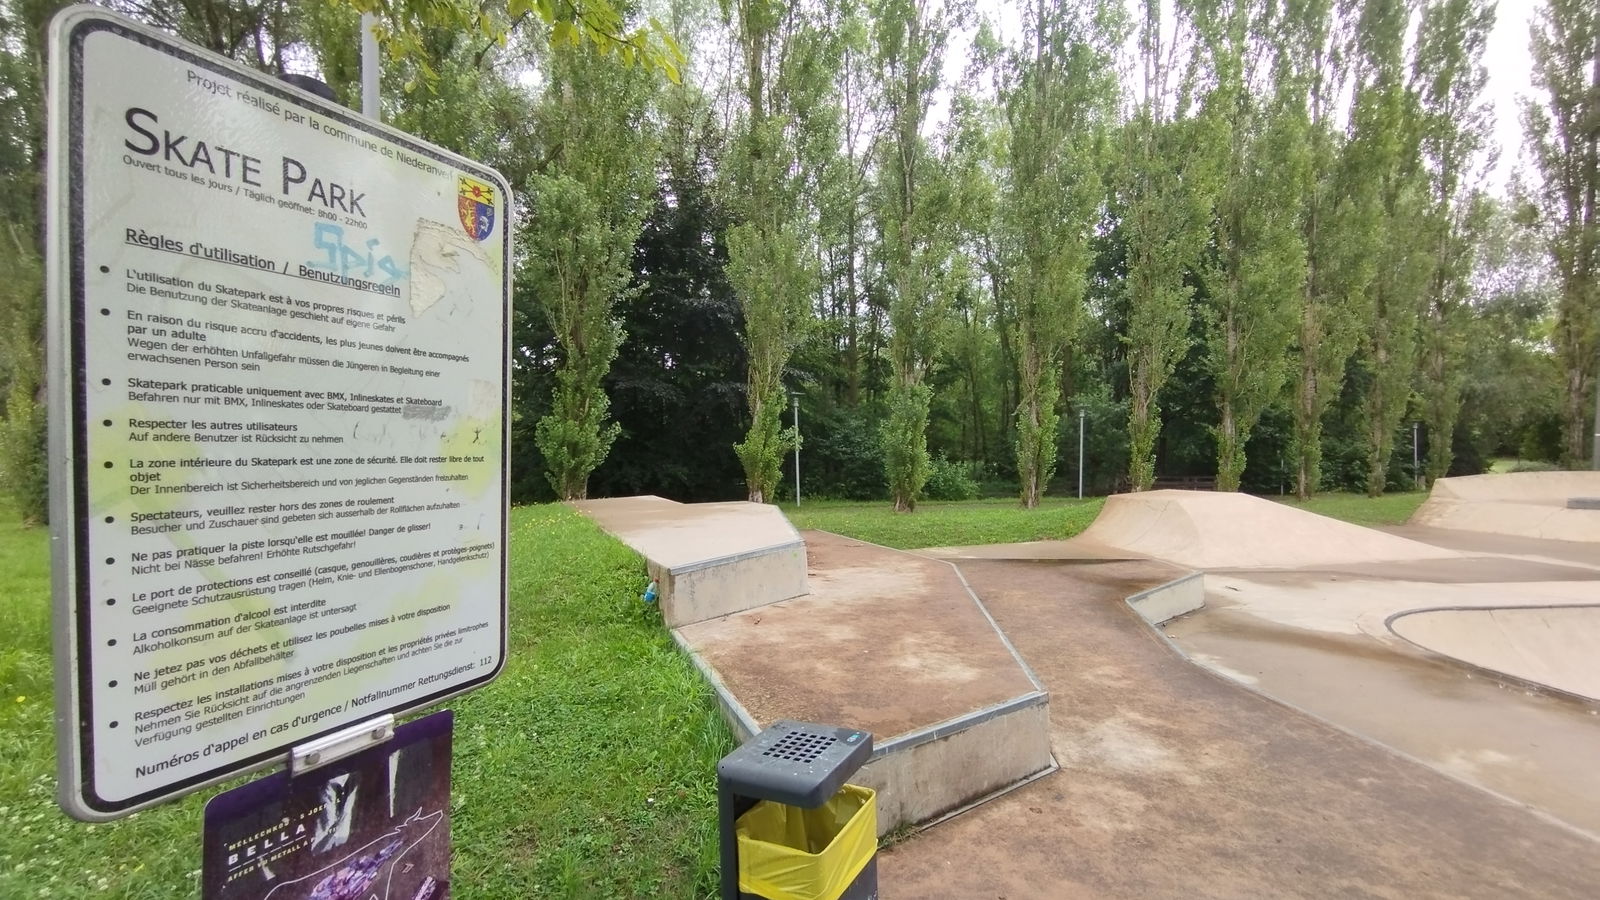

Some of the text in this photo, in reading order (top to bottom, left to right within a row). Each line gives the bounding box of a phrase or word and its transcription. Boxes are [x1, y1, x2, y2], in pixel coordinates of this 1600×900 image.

[186, 69, 232, 98] Projet
[236, 90, 280, 116] réalisé
[284, 109, 306, 124] par
[308, 116, 319, 130] la
[322, 124, 378, 152] commune
[379, 145, 393, 159] de
[122, 154, 161, 174] Ouvert
[163, 166, 188, 180] tous
[190, 172, 205, 185] les
[208, 178, 233, 192] jours
[242, 187, 275, 204] Täglich
[277, 199, 315, 215] geöffnet:
[317, 208, 337, 222] 8h00
[344, 216, 367, 230] 22h00
[125, 227, 184, 255] Règles
[298, 264, 400, 297] Benutzungsregeln
[126, 282, 208, 306] Die Benutzung
[197, 281, 212, 292] du
[215, 283, 266, 301] Skatepark
[268, 294, 284, 304] est
[294, 299, 310, 308] vos
[312, 302, 344, 314] propres
[127, 325, 206, 342] par un adulte
[127, 309, 143, 321] En
[147, 313, 183, 326] raison
[186, 318, 201, 328] du
[204, 320, 238, 333] risque
[427, 351, 469, 362] accompagnés
[127, 337, 330, 366] Wegen der erhöhten müssen
[127, 352, 238, 369] erwachsenen Person
[127, 377, 442, 406] Skatepark praticable uniquement avec BMX, Skateboard
[128, 390, 369, 412] Befahren nur mit BMX, oder Skateboard
[128, 418, 298, 431] Respecter les autres utilisateurs
[128, 431, 344, 443] Auf andere Benutzer nehmen
[129, 458, 144, 468] La
[147, 459, 176, 468] zone
[179, 456, 232, 467] intérieure
[234, 457, 248, 466] du
[250, 456, 298, 467] Skatepark
[299, 457, 314, 466] est
[333, 457, 353, 465] zone
[354, 456, 365, 464] de
[366, 455, 398, 464] sécurité.
[129, 471, 161, 483] objet
[129, 482, 224, 495] Der Innenbereich
[130, 498, 355, 523] Spectateurs, veuillez rester hors des zones de
[130, 513, 316, 535] Besucher und Zuschauer gebeten
[131, 552, 148, 562] Ne
[151, 550, 172, 562] pas
[176, 544, 226, 559] pratiquer
[228, 542, 238, 551] la
[241, 540, 265, 552] piste
[314, 533, 328, 542] est
[368, 527, 395, 536] Danger
[131, 551, 263, 575] Nicht Nässe befahren!
[132, 551, 431, 602] Le port de protections est conseillé (casque, coudières
[132, 585, 276, 615] Geeignete Schutzausrüstung
[132, 632, 147, 642] La
[151, 616, 230, 638] consommation
[272, 605, 288, 615] est
[132, 603, 357, 655] Alkoholkonsum auf untersagt
[134, 671, 150, 682] Ne
[153, 663, 183, 679] jetez
[186, 658, 205, 672] pas
[208, 653, 227, 664] vos
[229, 644, 268, 660] déchets
[270, 640, 280, 650] et
[134, 665, 230, 695] Müll gehört den
[134, 699, 193, 721] Respectez
[196, 694, 212, 705] les
[215, 677, 274, 700] installations
[276, 670, 302, 683] mises
[335, 650, 376, 667] disposition
[134, 715, 181, 734] Nehmen
[135, 750, 199, 778] Numéros
[252, 729, 267, 740] en
[270, 721, 289, 735] cas
[351, 680, 416, 708] Notfallnummer
[417, 661, 475, 686] Rettungsdienst:
[479, 655, 492, 666] 112
[134, 724, 192, 747] Verfügung
[228, 823, 306, 866] BELLA
